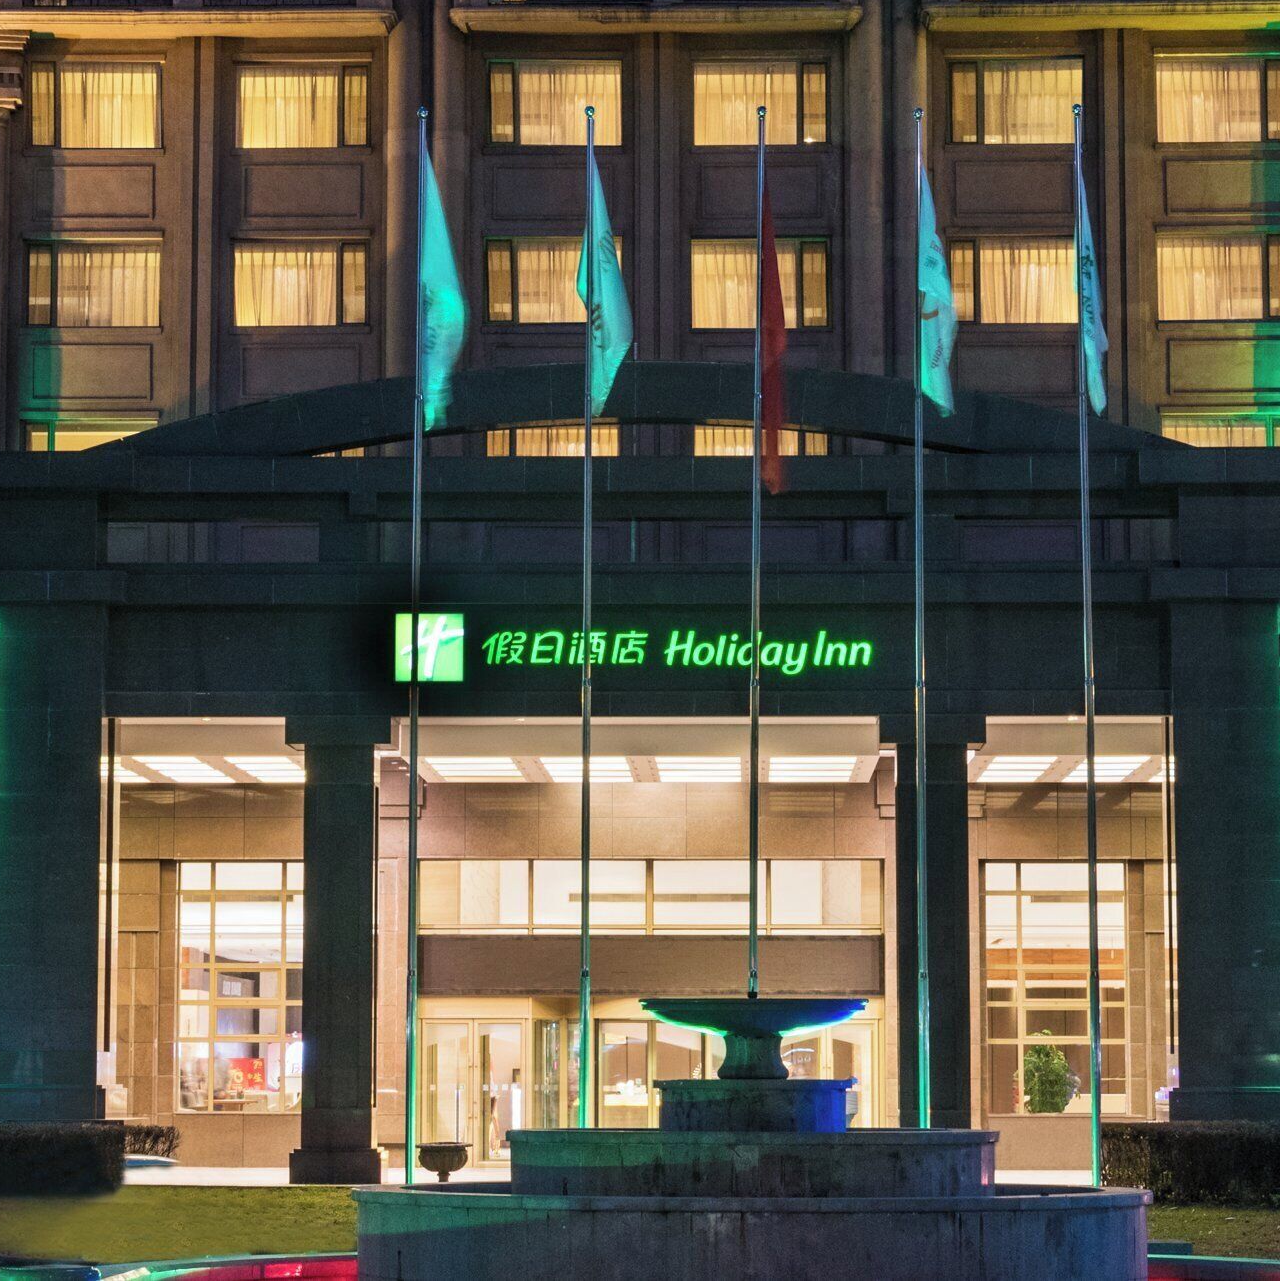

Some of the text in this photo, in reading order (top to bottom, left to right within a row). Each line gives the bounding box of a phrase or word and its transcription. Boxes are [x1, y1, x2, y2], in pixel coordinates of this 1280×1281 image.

[481, 629, 650, 665] 假日酒店
[663, 629, 873, 675] Holiday Inn
